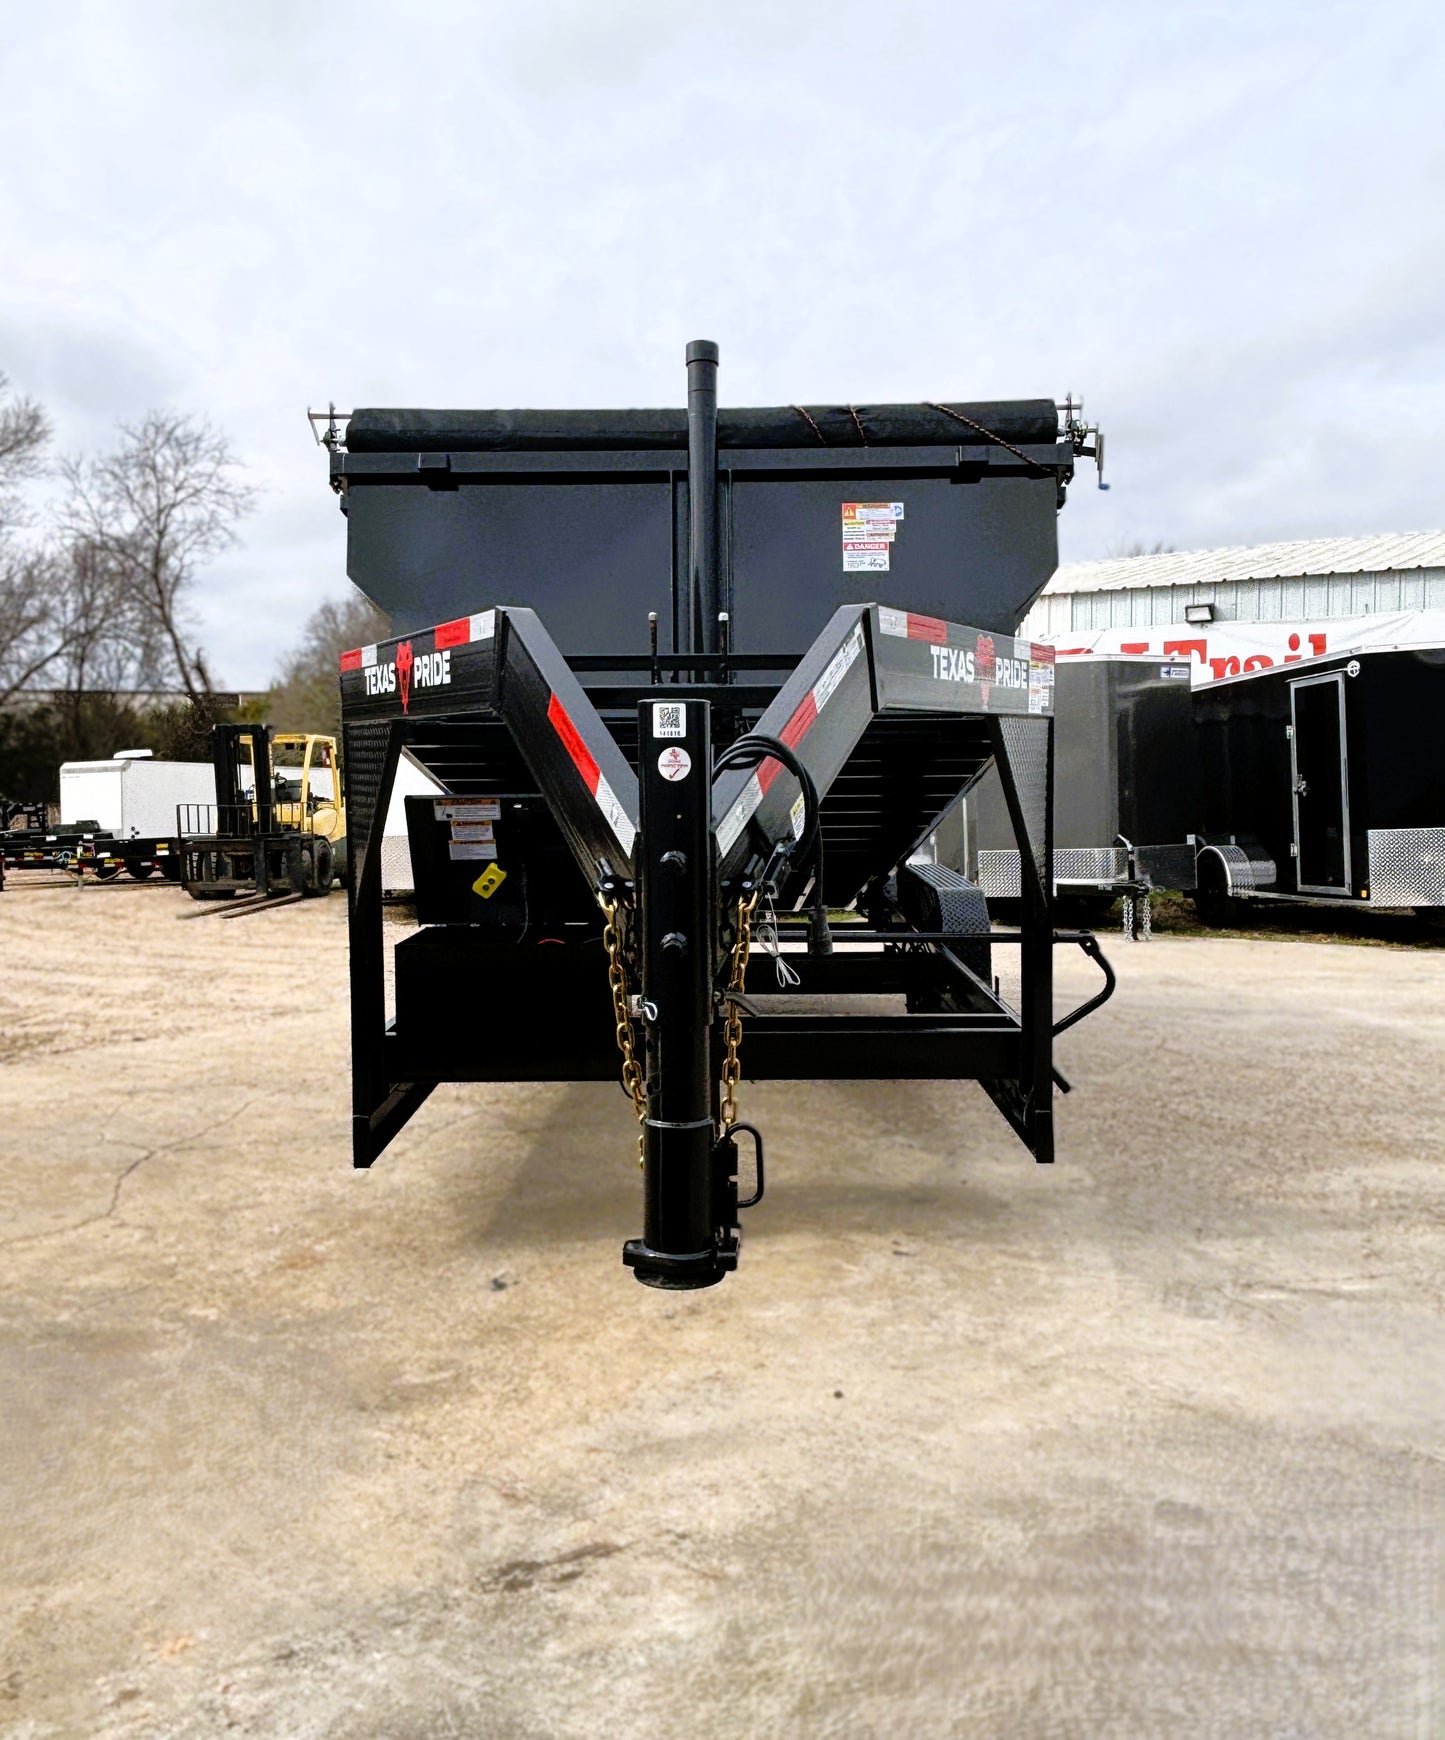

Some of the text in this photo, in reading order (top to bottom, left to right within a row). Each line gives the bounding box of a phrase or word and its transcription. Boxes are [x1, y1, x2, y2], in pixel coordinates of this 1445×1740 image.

[365, 651, 451, 696] TEXAS PRIDE
[931, 646, 975, 682] TEXAS
[996, 657, 1027, 689] PRIDE
